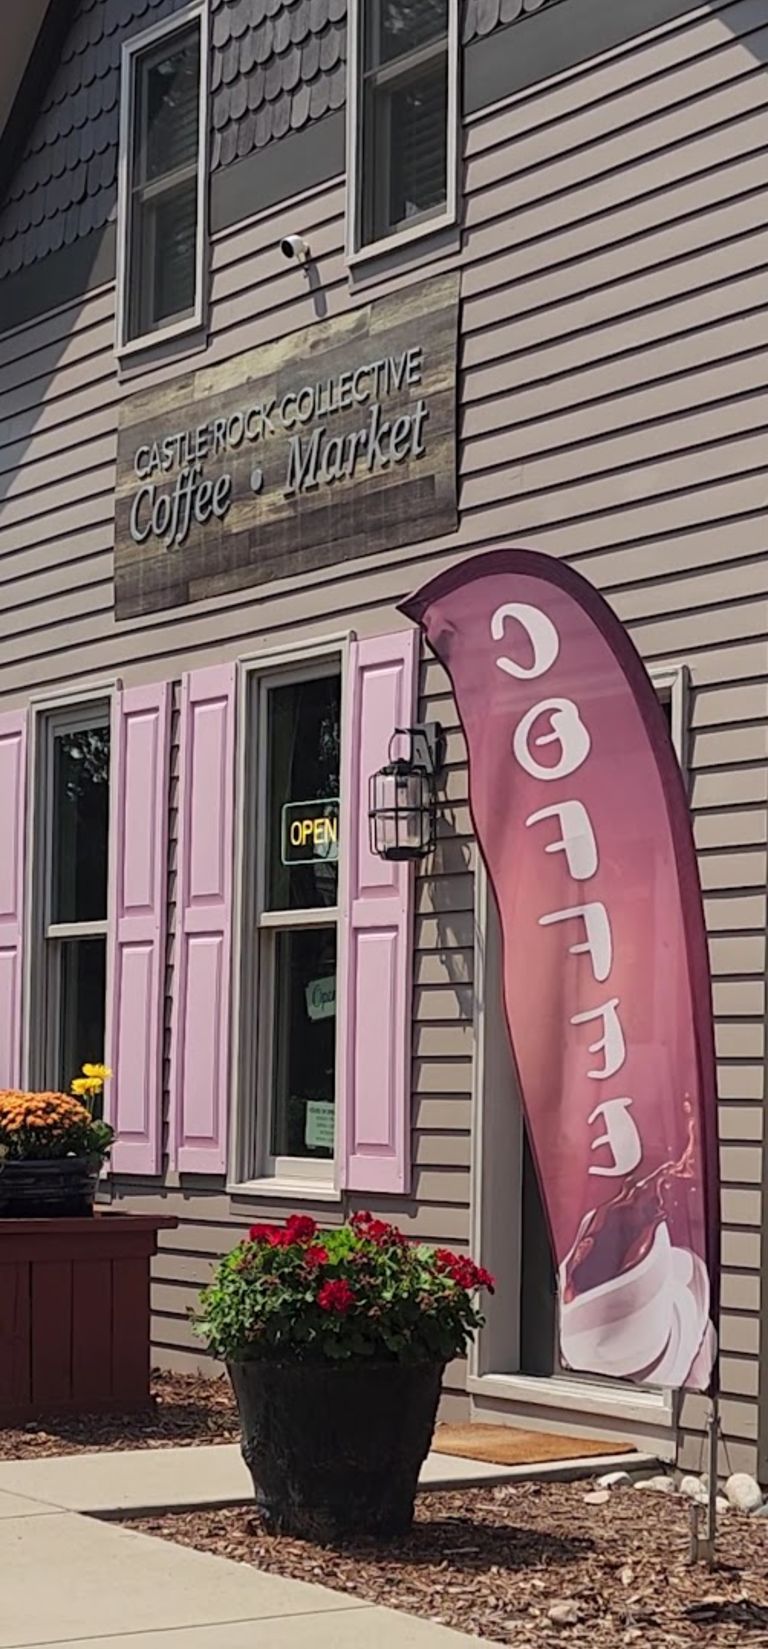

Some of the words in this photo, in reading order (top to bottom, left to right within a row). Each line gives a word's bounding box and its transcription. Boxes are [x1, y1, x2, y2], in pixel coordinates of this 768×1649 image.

[130, 465, 231, 548] Coffee
[283, 400, 429, 498] Market
[134, 424, 208, 479] CASTLE
[212, 400, 275, 452] ROCK
[279, 347, 423, 429] COLLECTIVE
[290, 817, 338, 846] OPEN
